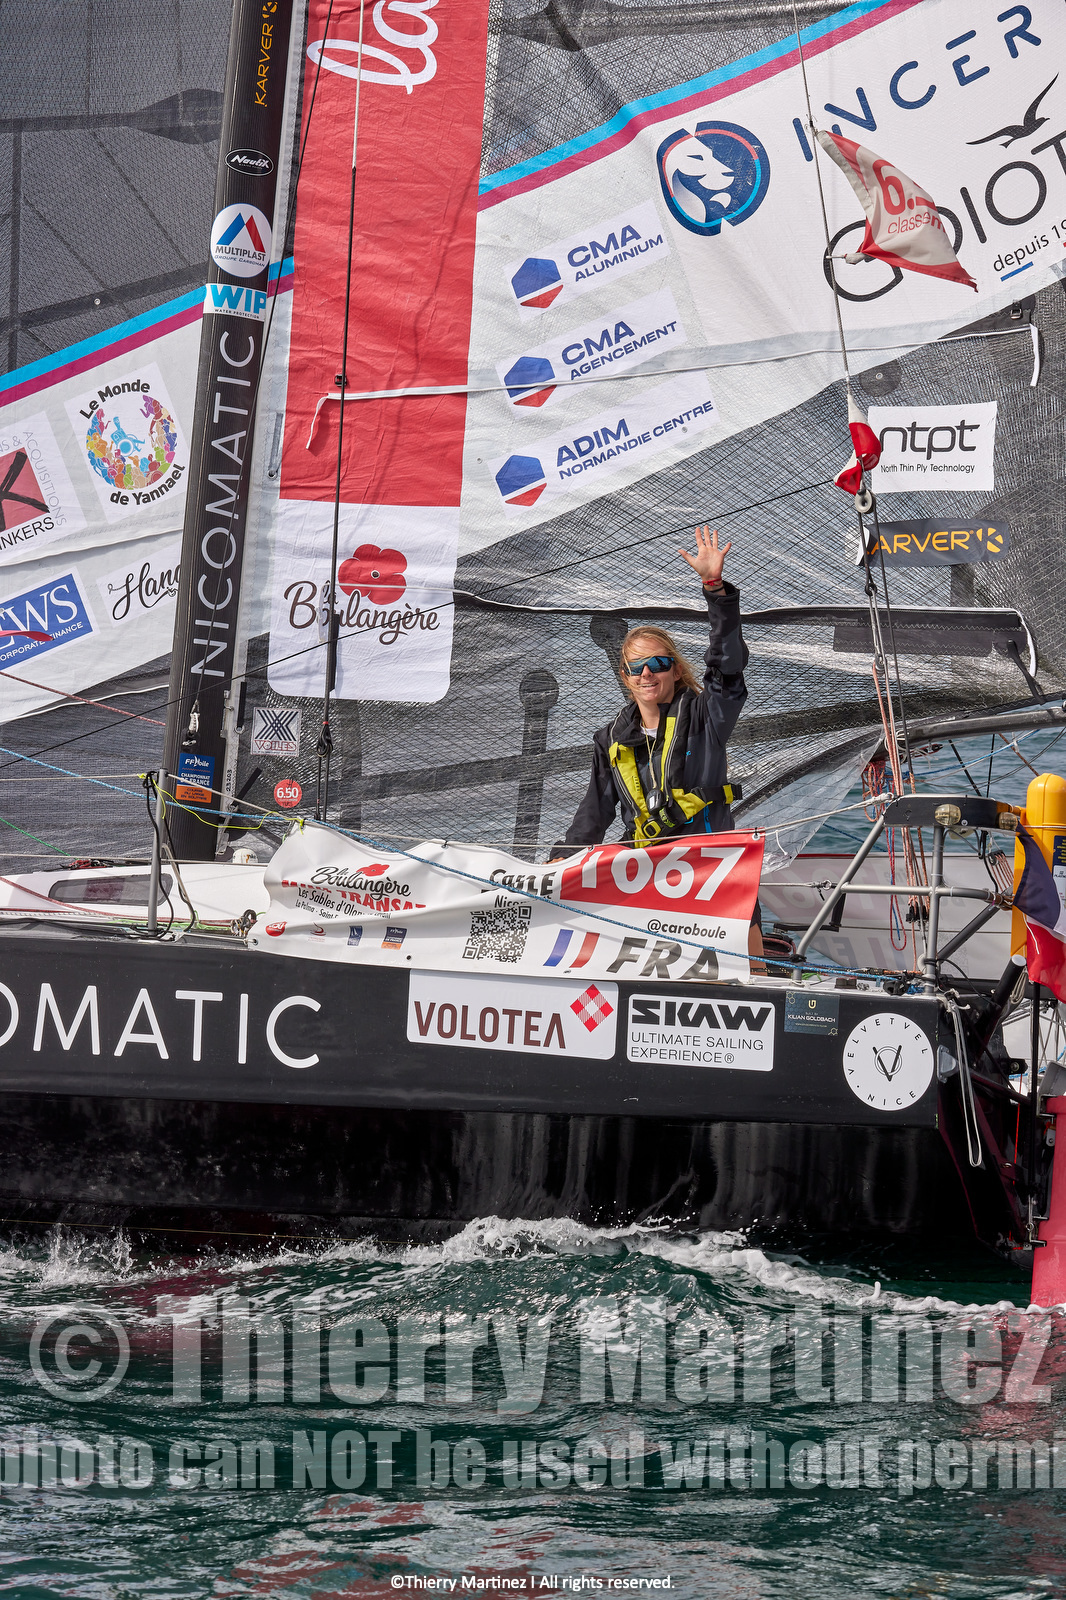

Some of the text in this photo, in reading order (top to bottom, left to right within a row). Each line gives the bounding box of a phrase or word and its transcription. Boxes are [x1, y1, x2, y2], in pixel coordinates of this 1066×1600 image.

[254, 23, 274, 107] KARVER
[214, 245, 266, 262] MULTIPLAST
[567, 224, 642, 268] CMA
[575, 234, 664, 283] ALUMINIUM
[993, 235, 1050, 272] depuis
[210, 284, 267, 315] WIP
[561, 320, 635, 366] CMA
[570, 320, 677, 380] AGENCEMENT
[79, 379, 151, 419] Le Monde
[556, 418, 631, 468] ADIM
[558, 400, 714, 480] NORMANDIE CENTRE
[880, 419, 981, 460] ntpt
[22, 430, 67, 527] ACQUISITIONS
[110, 463, 186, 506] de Yannael
[880, 463, 975, 474] North Thin Ply Technology
[190, 330, 255, 678] NICOMATIC
[0, 516, 55, 550] NKERS
[868, 530, 970, 554] ARVER
[254, 739, 297, 752] VOILES
[276, 787, 299, 799] 6.50
[310, 866, 412, 901] Boulangère
[582, 846, 746, 901] 1067
[298, 887, 308, 899] Les
[309, 889, 336, 909] Sables
[647, 918, 727, 940] @caroboule
[605, 936, 720, 981] FRA
[0, 981, 322, 1069] MATIC
[413, 1000, 567, 1050] VOLOTEA
[631, 998, 773, 1032] SKAW
[806, 1015, 836, 1023] GOLDBACH
[631, 1031, 764, 1051] ULTIMATE SAILING
[867, 1090, 917, 1106] NICE
